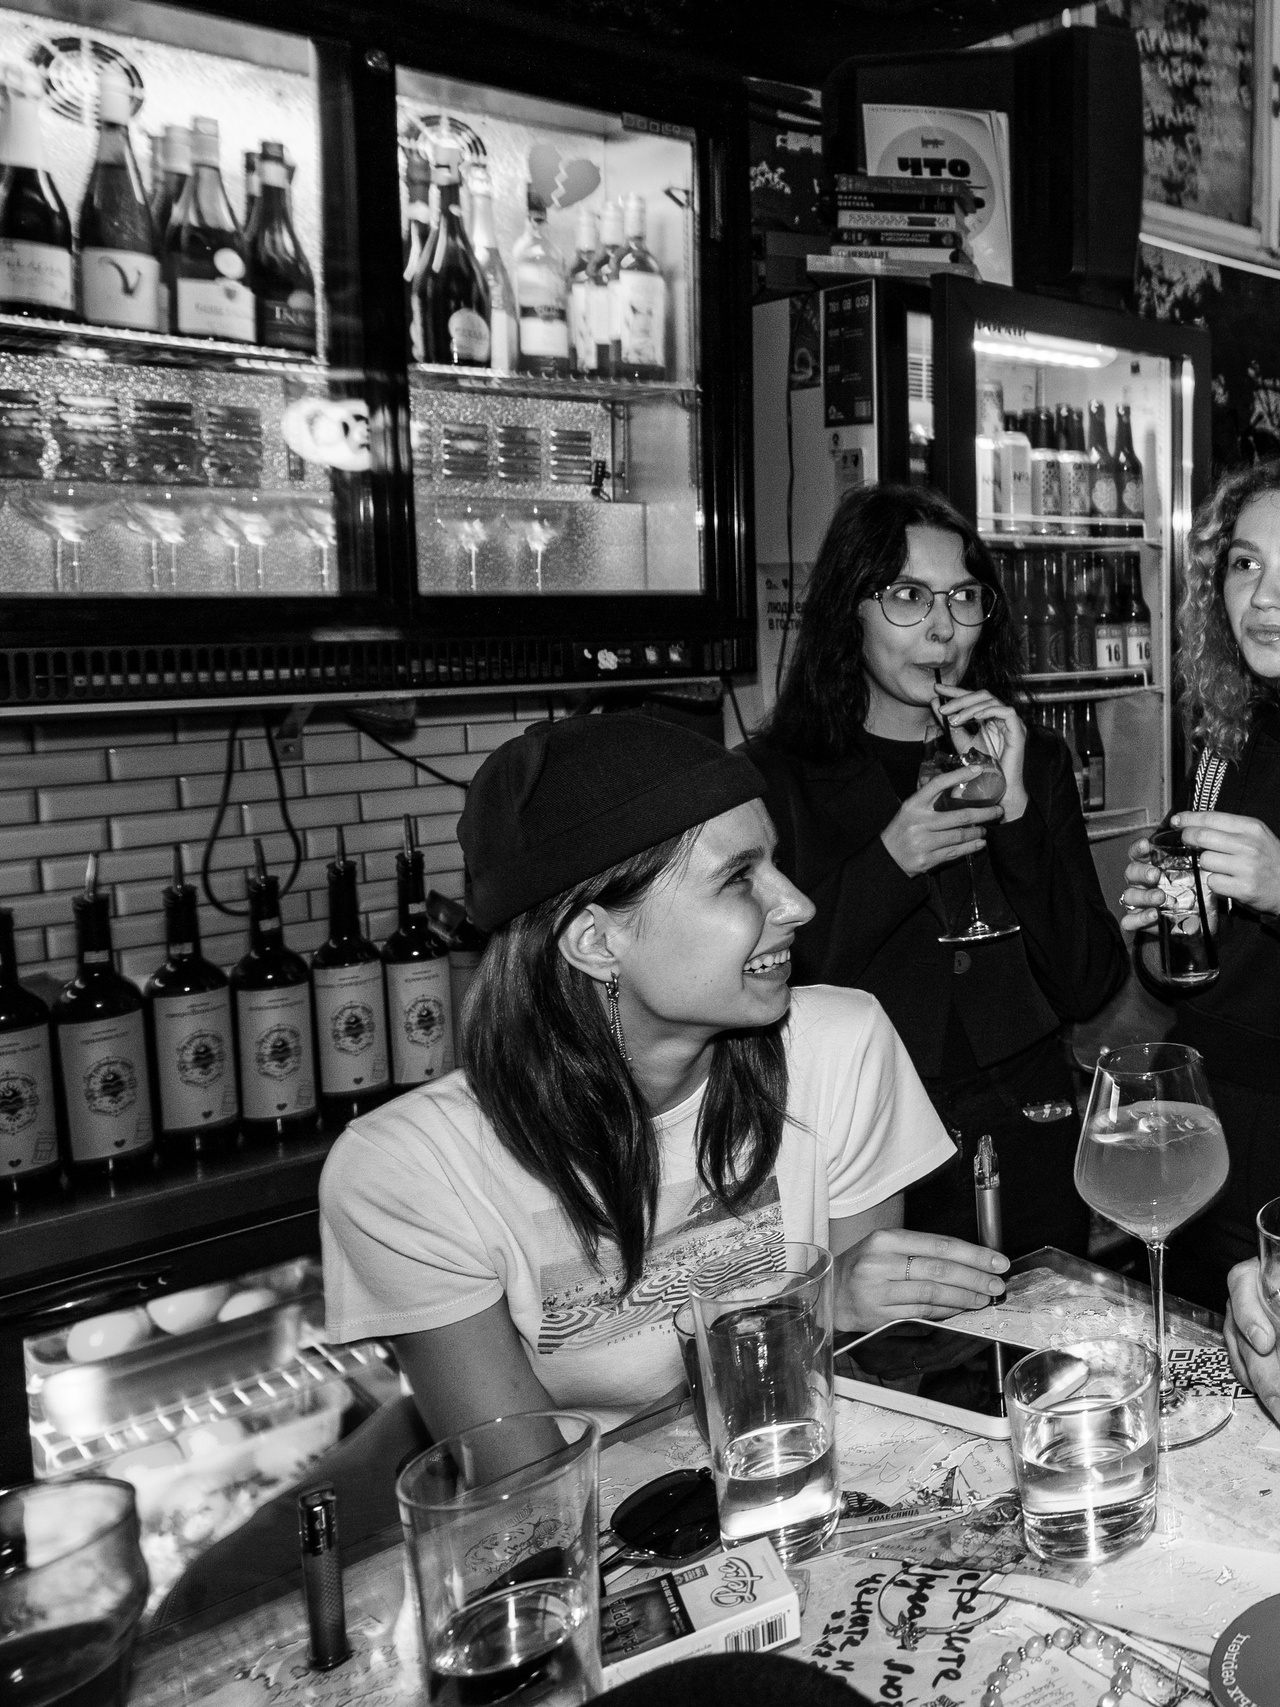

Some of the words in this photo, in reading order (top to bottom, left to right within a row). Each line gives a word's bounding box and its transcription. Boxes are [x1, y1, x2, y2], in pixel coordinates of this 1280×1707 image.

[897, 156, 971, 178] ЧТО
[1106, 643, 1121, 662] 16
[868, 1509, 920, 1523] КОЛЕСНИЦА
[1221, 1633, 1251, 1686] сердец
